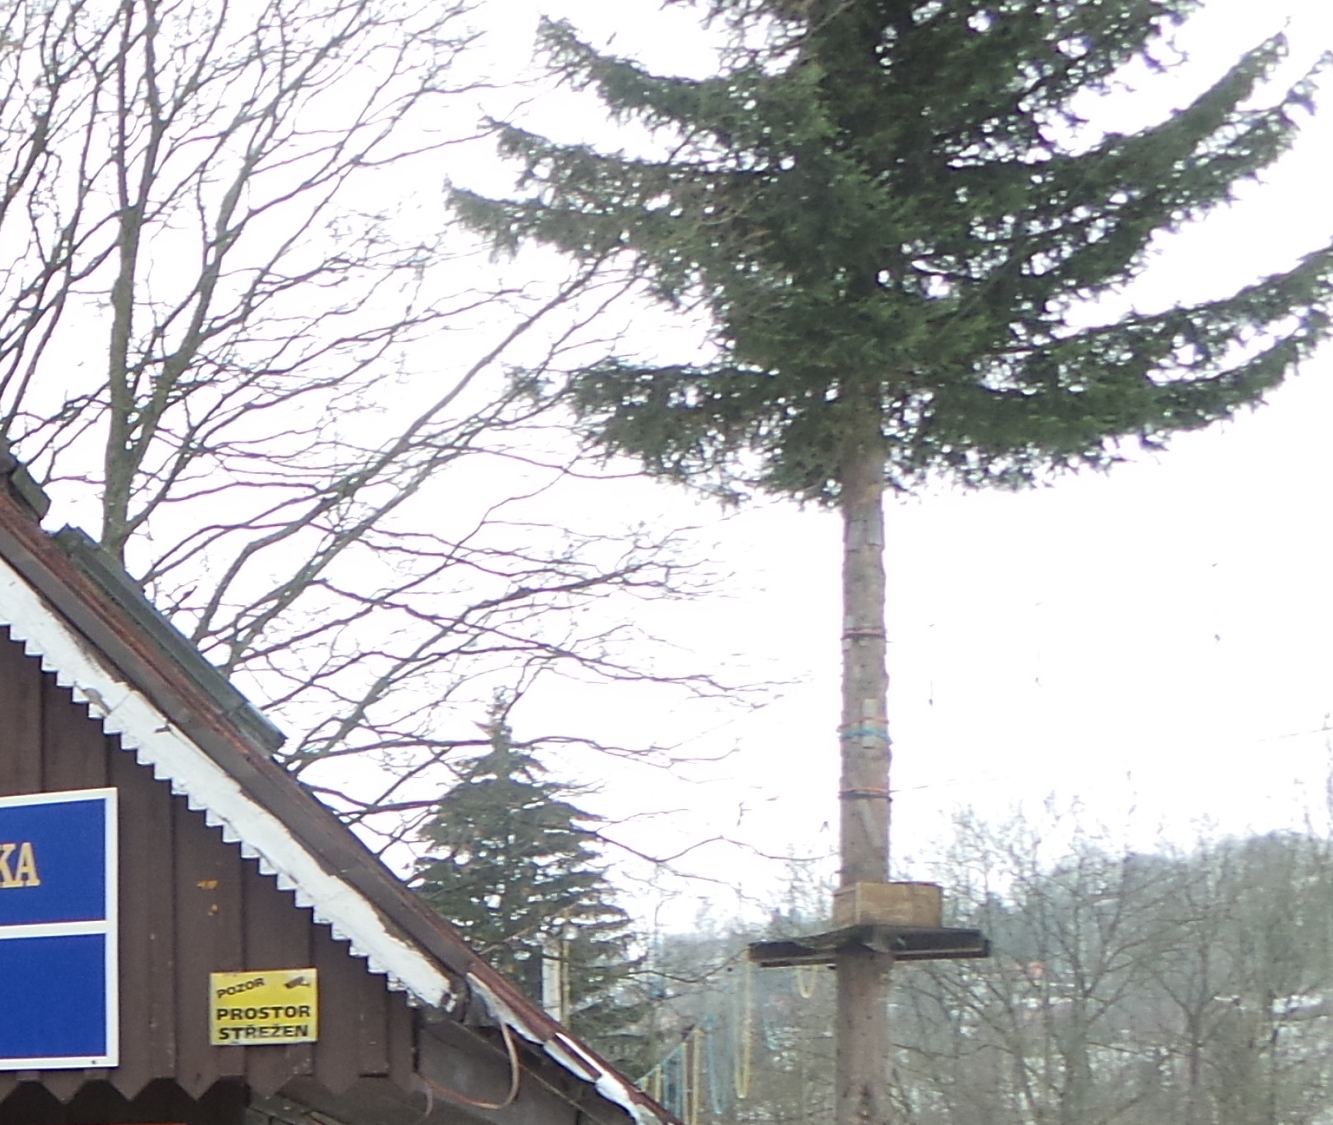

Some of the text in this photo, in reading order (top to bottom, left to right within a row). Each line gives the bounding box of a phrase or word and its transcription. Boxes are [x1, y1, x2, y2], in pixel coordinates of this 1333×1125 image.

[216, 977, 265, 999] POZOR
[216, 1005, 311, 1021] PROSTOR
[218, 1023, 309, 1040] STŘEŽEN
